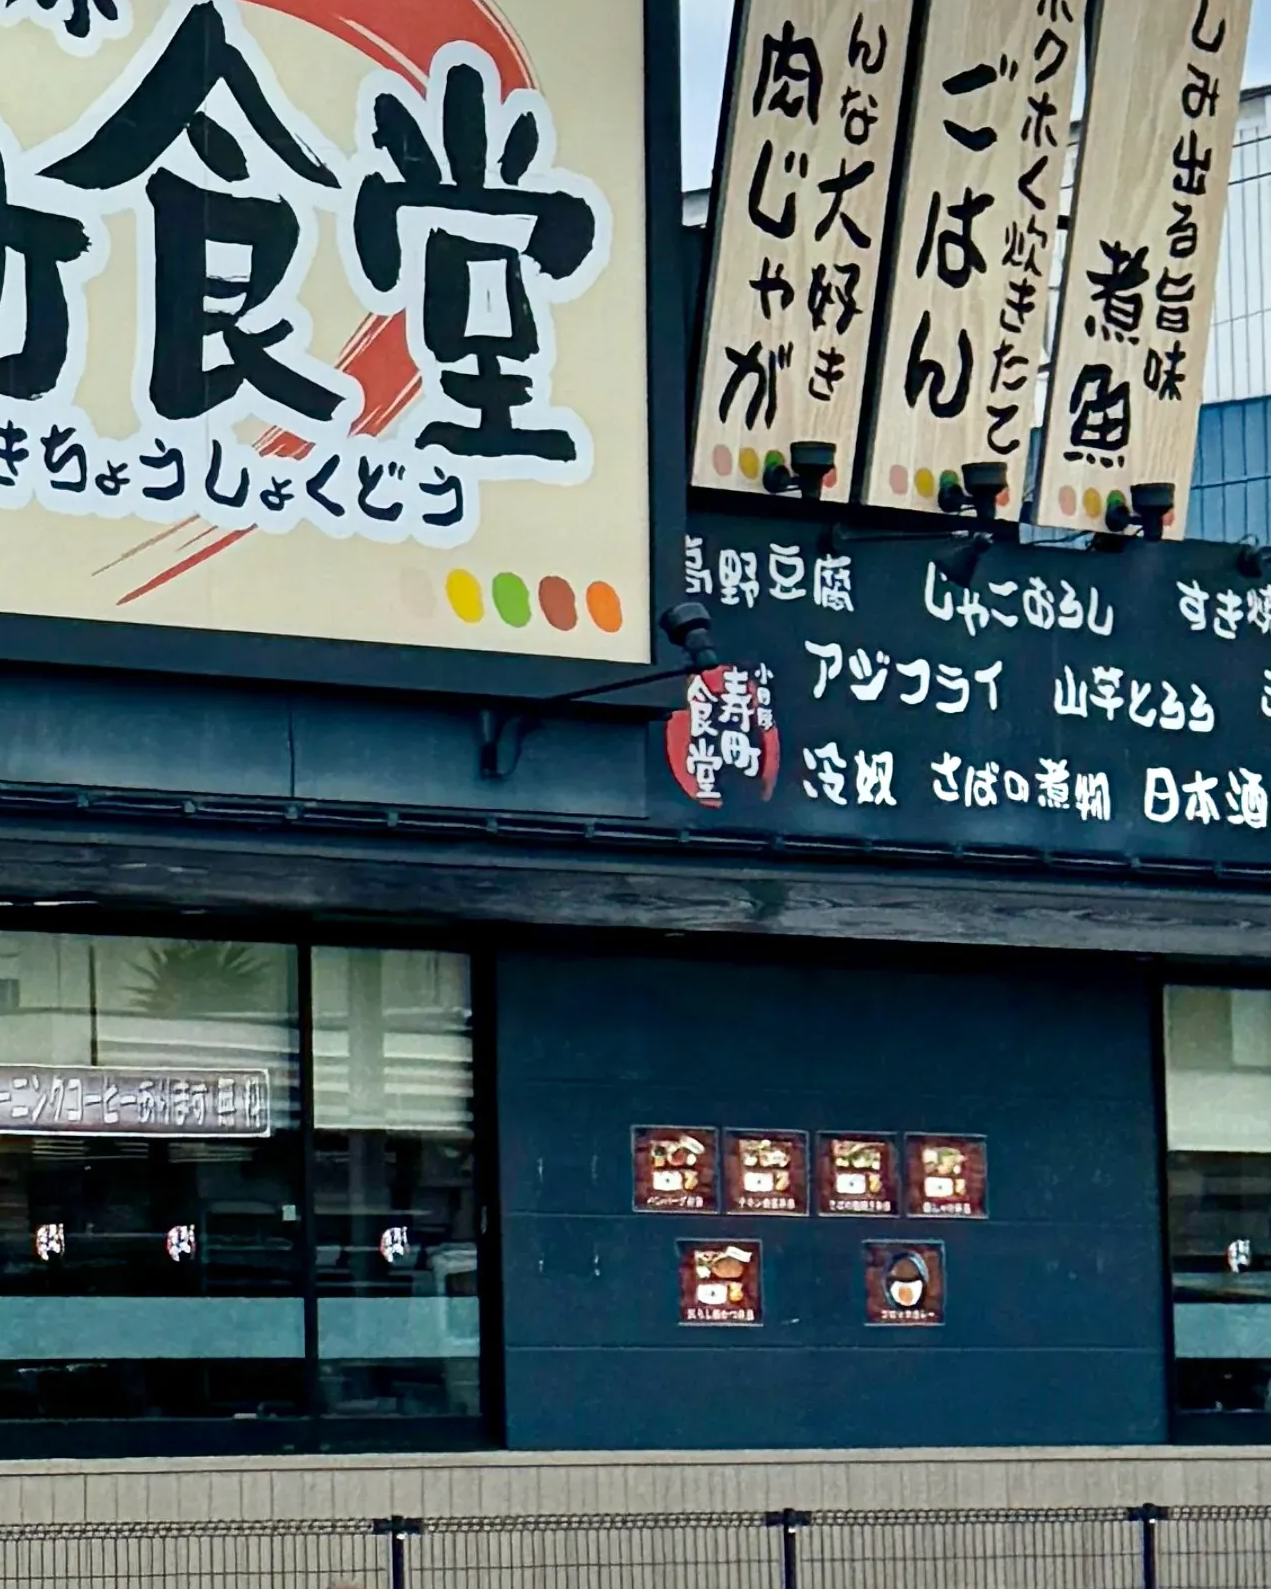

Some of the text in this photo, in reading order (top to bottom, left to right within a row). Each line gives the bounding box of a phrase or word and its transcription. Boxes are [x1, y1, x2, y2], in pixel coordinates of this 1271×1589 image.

[719, 20, 823, 430] 肉じゃが
[904, 53, 1018, 419] ごはん
[1063, 238, 1150, 467] 煮魚
[924, 561, 1114, 637] じゃこおろし
[805, 640, 1003, 713] アジフライ
[1054, 665, 1215, 732] 山芋とろろ
[802, 742, 1268, 829] 冷奴 さばの煮物 日本酒
